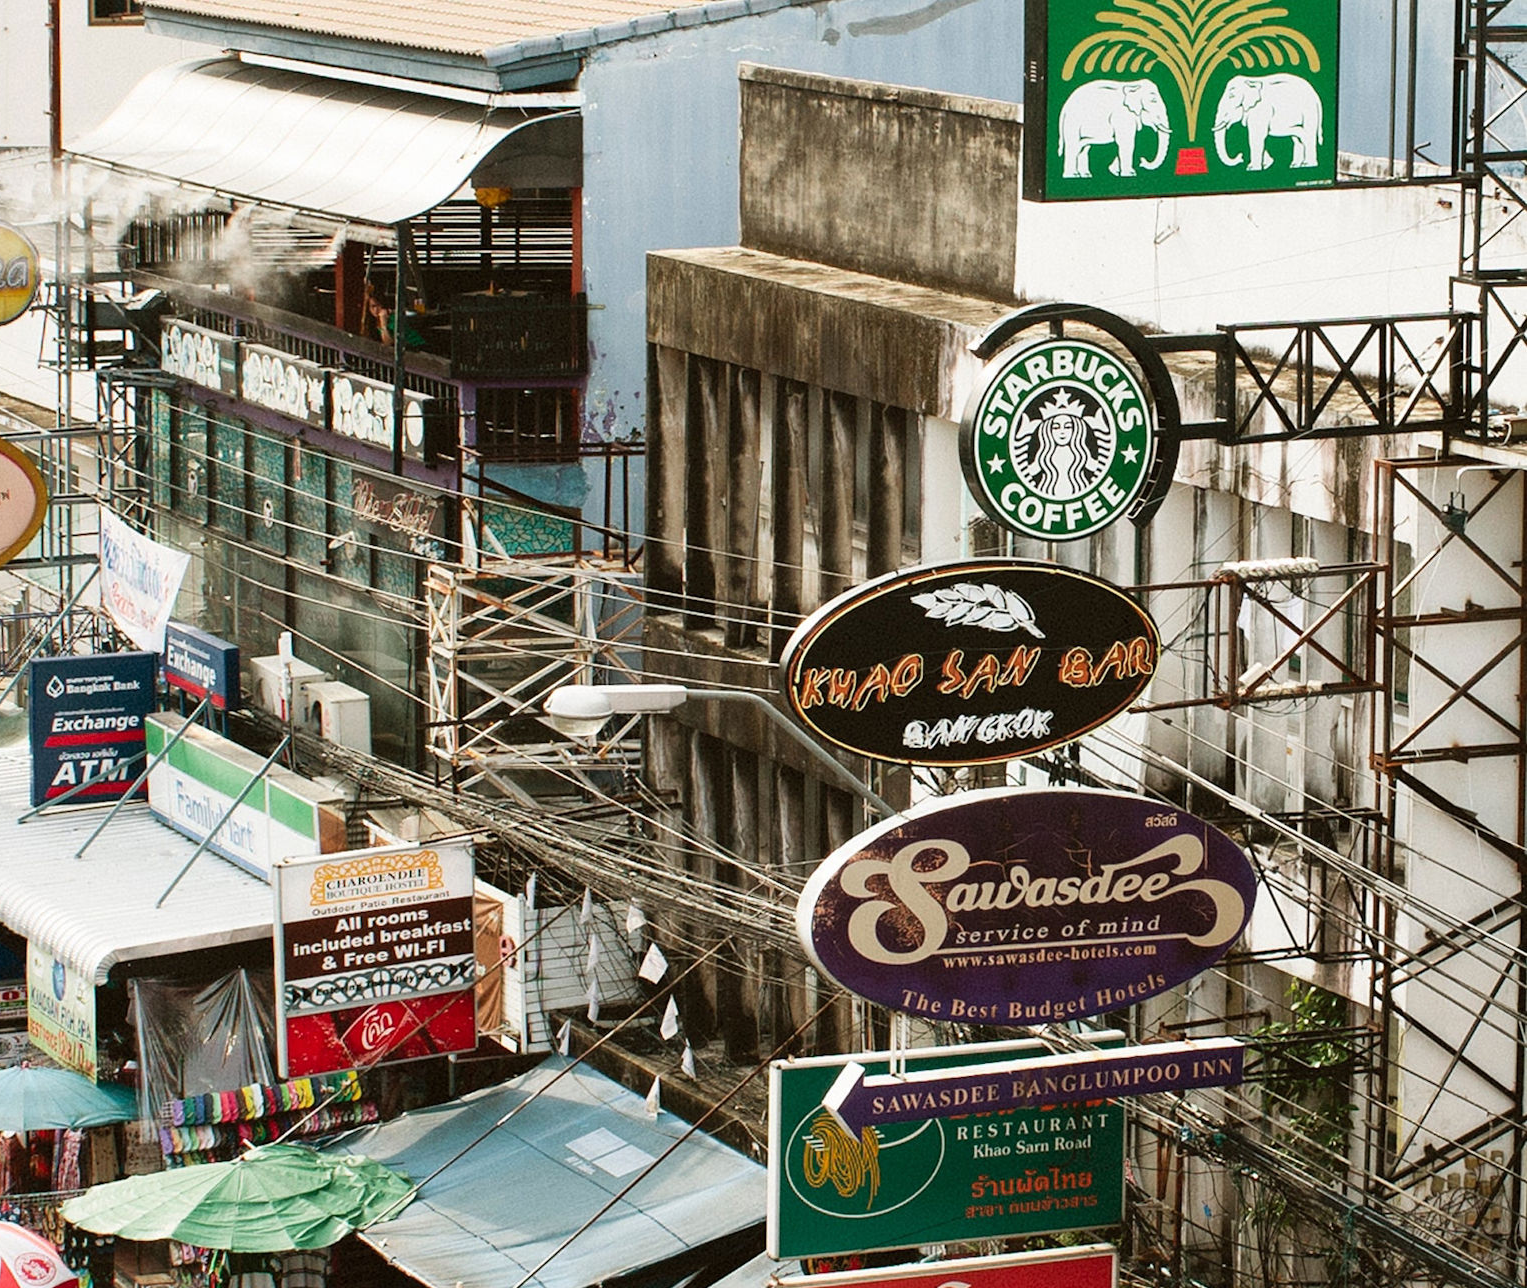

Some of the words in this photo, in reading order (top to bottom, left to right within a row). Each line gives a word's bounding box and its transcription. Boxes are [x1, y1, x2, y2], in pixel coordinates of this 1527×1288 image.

[982, 343, 1144, 441] STARBUCKS
[999, 481, 1127, 532] COFFEE
[167, 645, 217, 688] Exchange
[800, 652, 925, 712] KHAO
[939, 645, 1041, 699] SAN
[1058, 642, 1156, 686] BAR
[66, 682, 111, 695] Bangkok
[113, 680, 141, 692] Bank
[52, 713, 140, 734] Exchange
[902, 706, 1056, 749] BANGKOK
[52, 758, 131, 787] ATM
[326, 868, 427, 891] CHAROENDEE
[326, 882, 383, 900] BOUTIQUE
[384, 878, 427, 893] HOSTEL
[312, 902, 356, 916] Outdoor
[360, 898, 388, 910] Patio
[391, 890, 450, 907] Restaurant
[840, 831, 1246, 967] Sawasdee
[336, 916, 361, 933] All
[368, 908, 429, 929] rooms
[956, 926, 1050, 945] service
[1061, 922, 1092, 941] of
[1098, 914, 1161, 937] mind
[293, 933, 375, 957] included
[380, 918, 472, 945] breakfast
[322, 955, 337, 971] &
[344, 951, 389, 968] Free
[394, 939, 446, 960] WI-FI
[942, 941, 1159, 970] www.sawasdee-hotels.com
[901, 989, 944, 1016] The
[950, 997, 998, 1019] Best
[1007, 991, 1088, 1023] Budget
[1096, 971, 1168, 1008] Hotels
[872, 1083, 1001, 1115] SAWASDEE
[1011, 1062, 1181, 1098] BANGLUMPOO
[1193, 1057, 1235, 1078] INN
[957, 1113, 1110, 1141] RESTAURANT
[973, 1143, 1011, 1159] Khao
[1015, 1139, 1050, 1155] Sarn
[1054, 1135, 1091, 1151] Road
[971, 1167, 1094, 1199] ร้านผัดไทย
